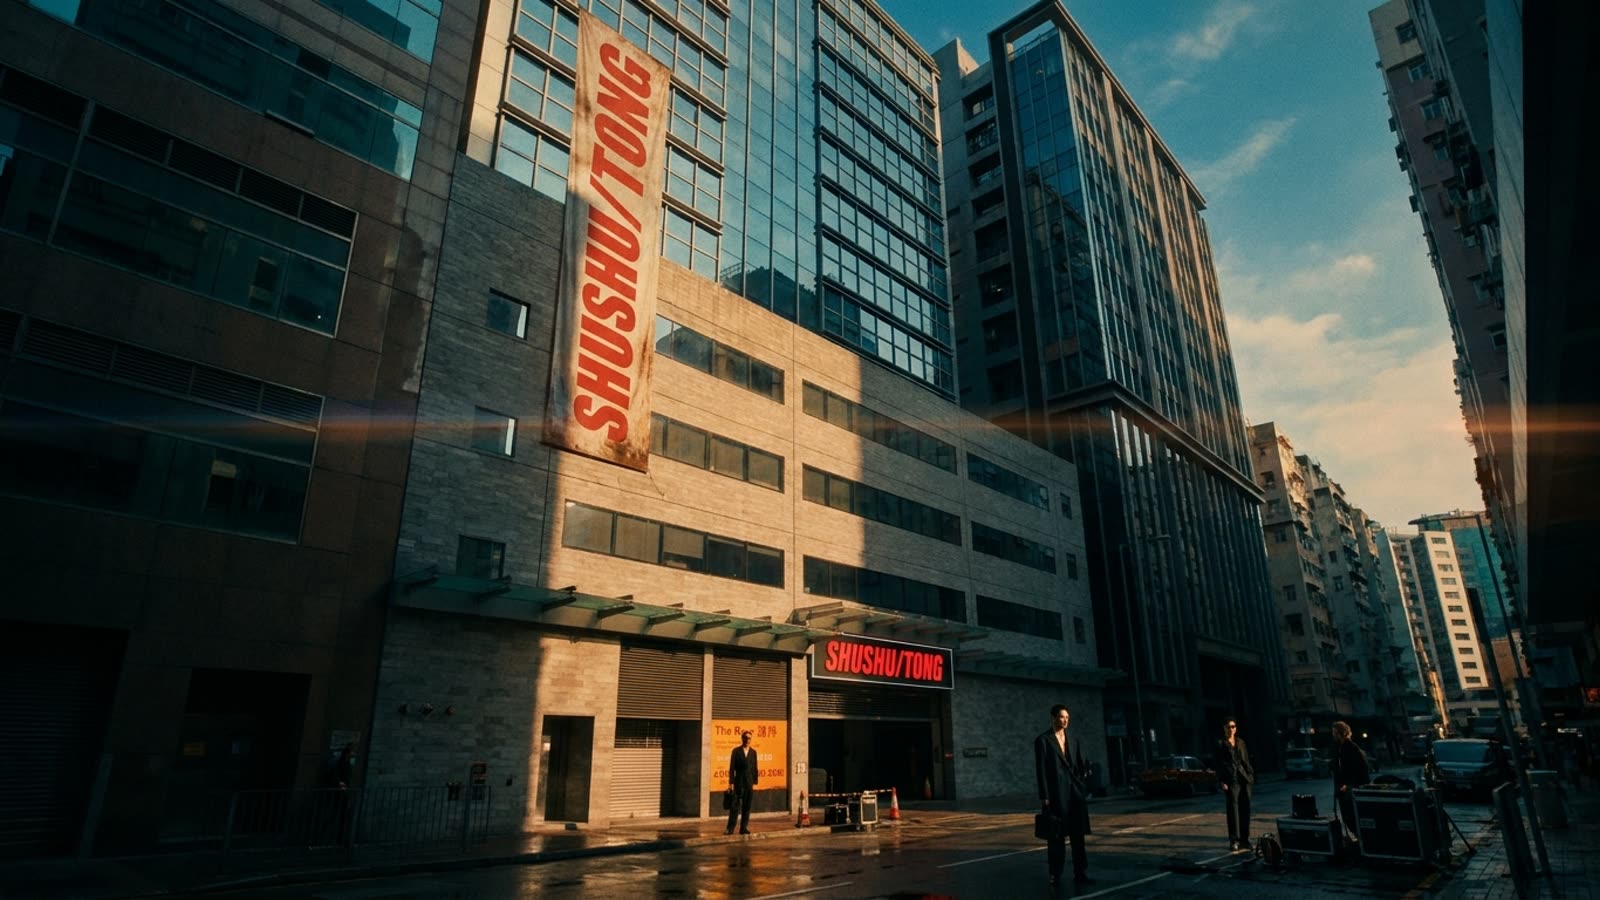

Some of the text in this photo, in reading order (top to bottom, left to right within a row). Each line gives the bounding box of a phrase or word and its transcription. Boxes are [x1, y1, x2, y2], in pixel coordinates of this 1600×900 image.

[574, 43, 651, 441] SHUSHU/TONG
[825, 640, 943, 681] SHUSHU/TONG
[716, 726, 731, 736] The
